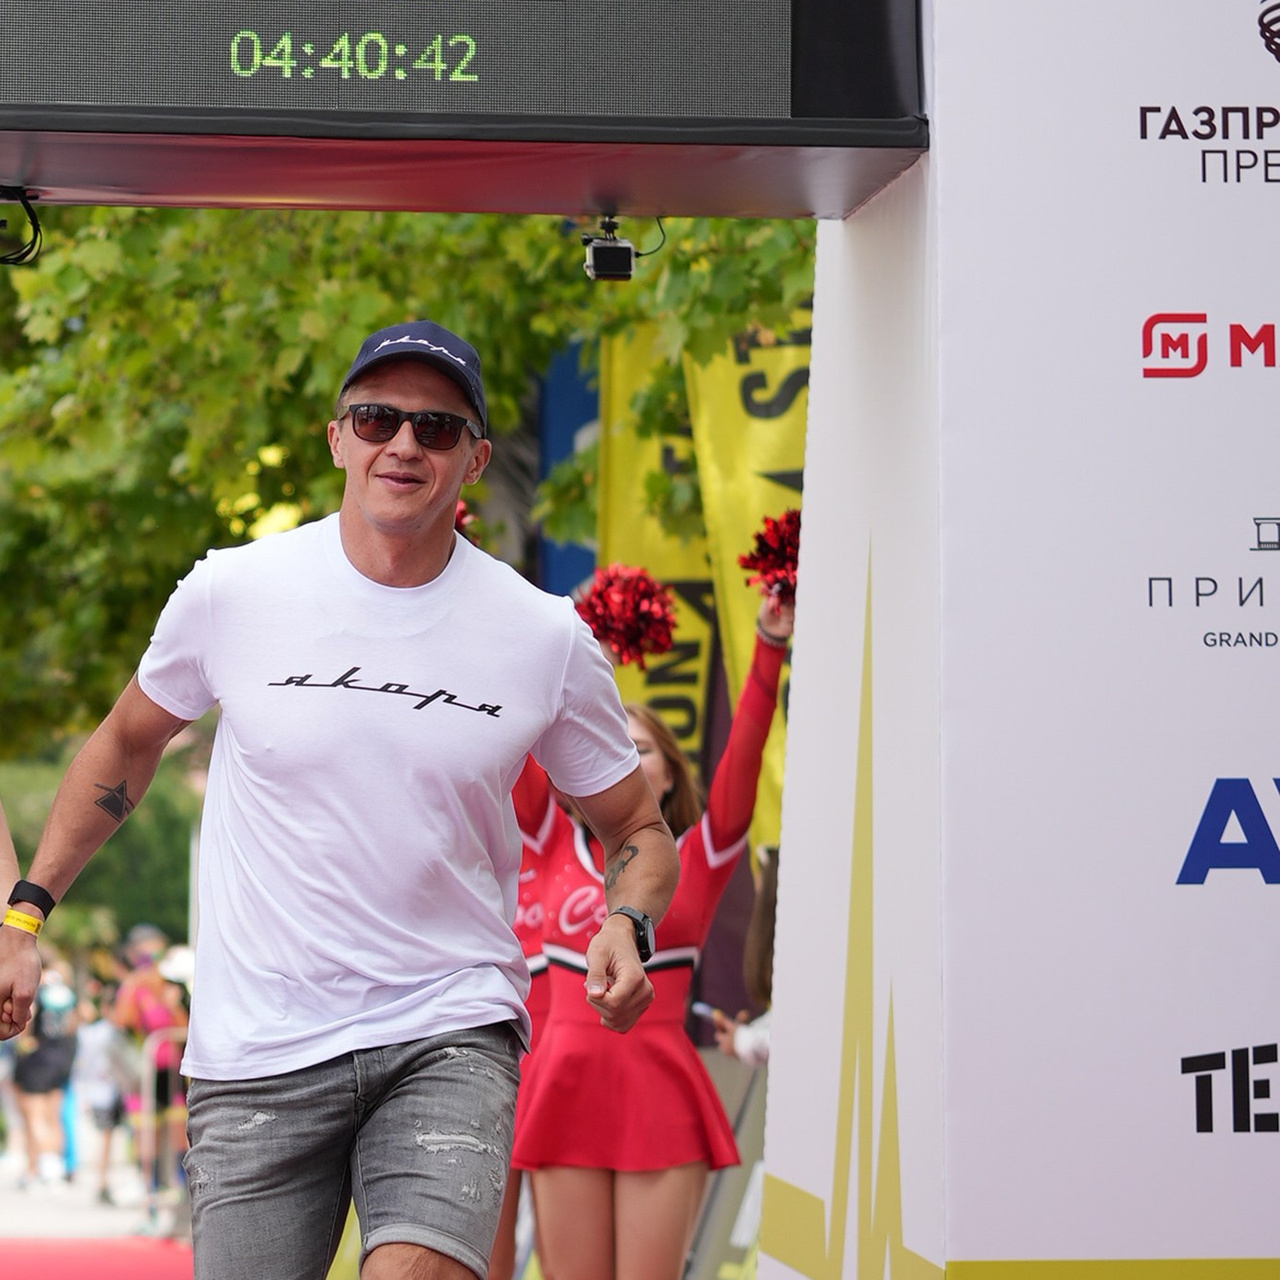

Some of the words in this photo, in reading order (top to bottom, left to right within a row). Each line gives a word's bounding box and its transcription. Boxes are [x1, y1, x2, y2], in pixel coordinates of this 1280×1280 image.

[230, 30, 479, 81] 04:40:42
[1139, 105, 1280, 140] ГАЗПР
[1201, 149, 1280, 183] ПРЕ
[1147, 576, 1264, 608] ПРИ
[1203, 631, 1280, 648] GRAND
